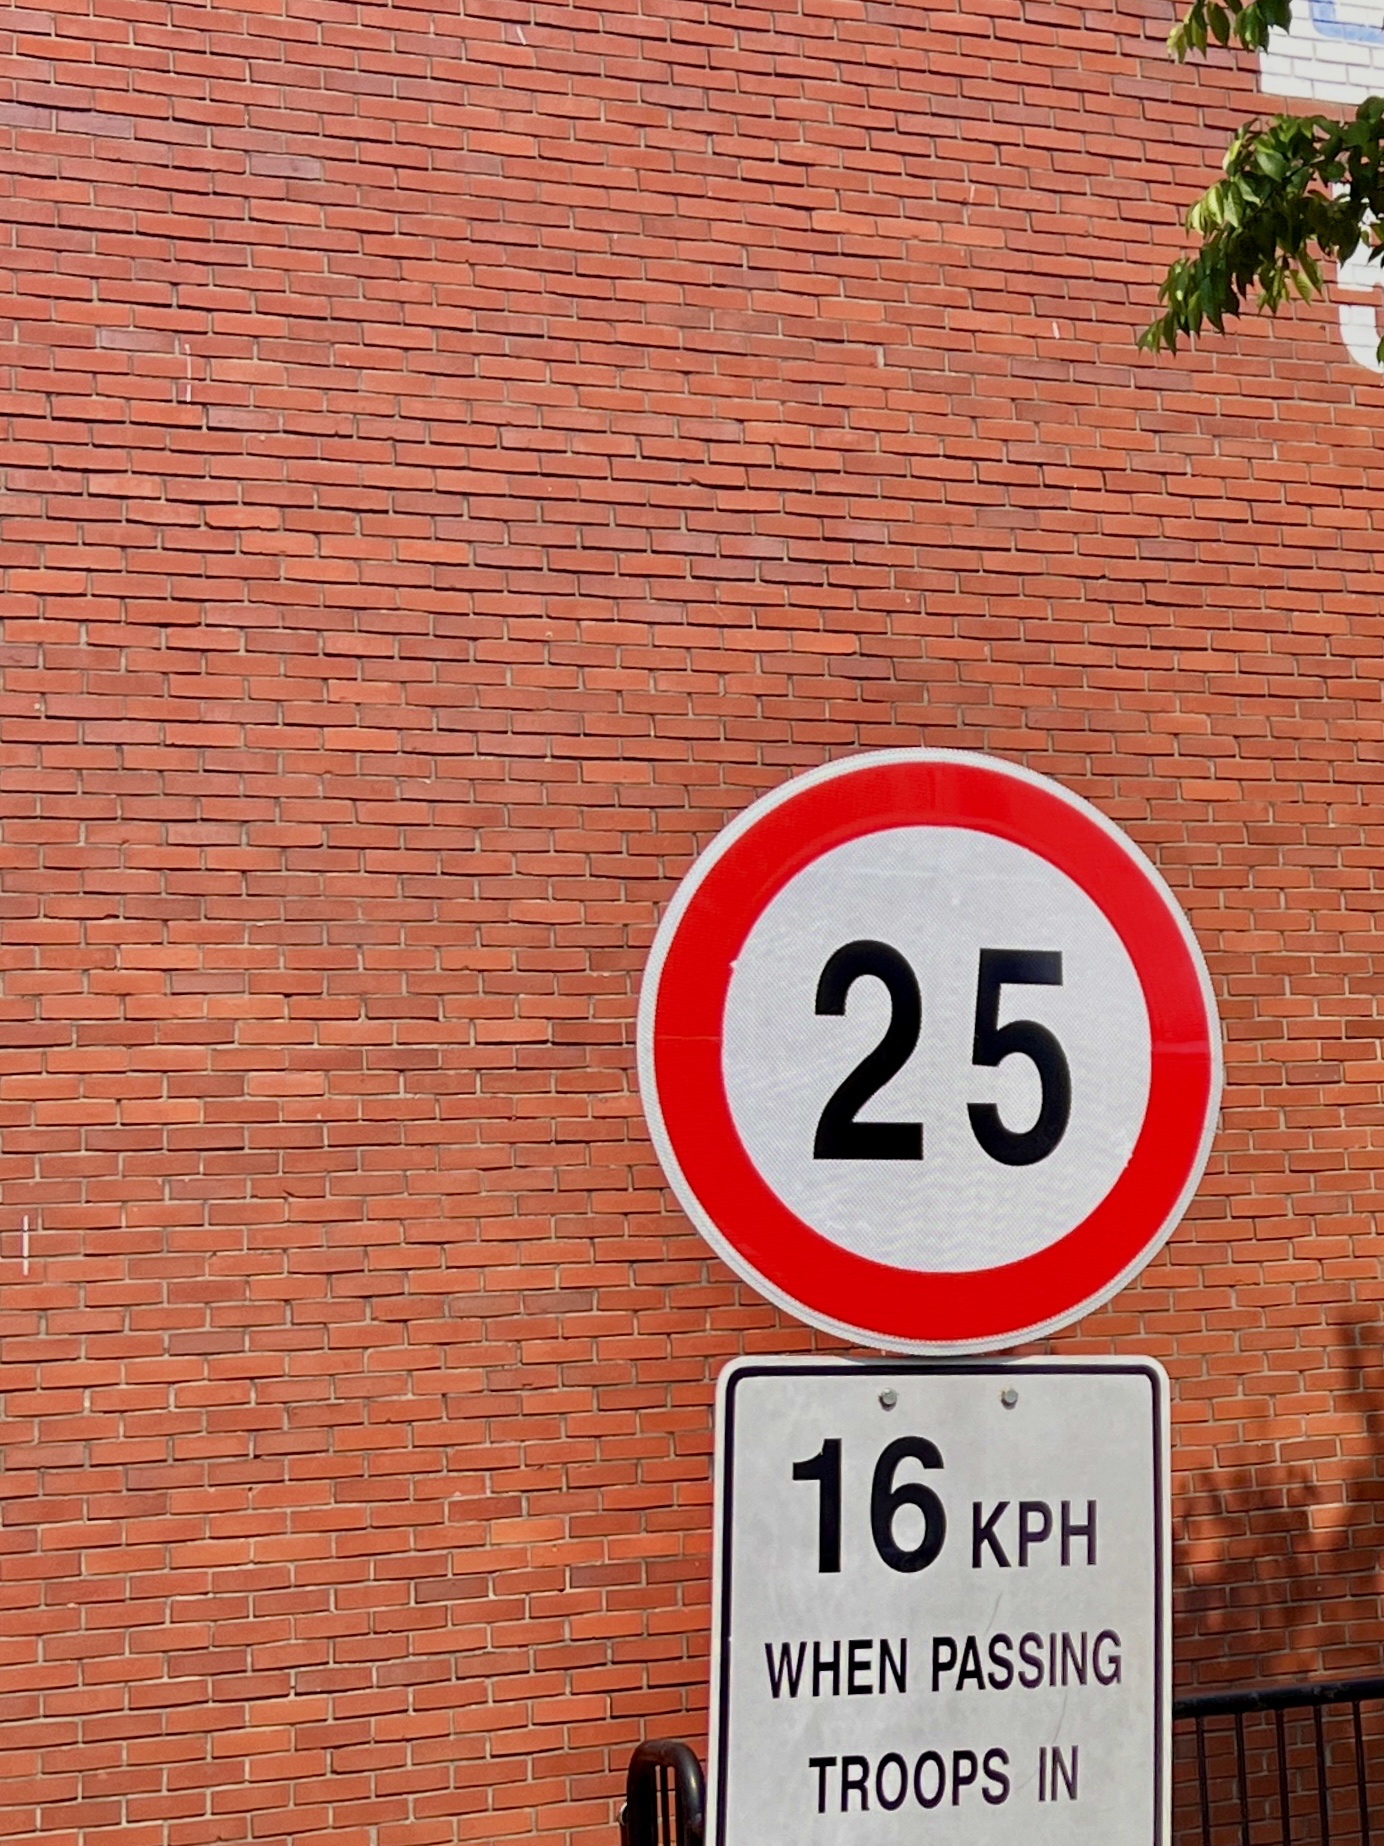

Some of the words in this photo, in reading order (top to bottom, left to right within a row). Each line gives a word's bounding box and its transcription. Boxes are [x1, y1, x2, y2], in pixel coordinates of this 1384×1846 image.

[813, 939, 1072, 1167] 25
[792, 1436, 947, 1574] 16
[971, 1500, 1098, 1569] KPH
[764, 1637, 907, 1699] WHEN
[931, 1629, 1122, 1692] PASSING
[808, 1750, 1011, 1814] TROOPS
[1038, 1745, 1079, 1802] IN
